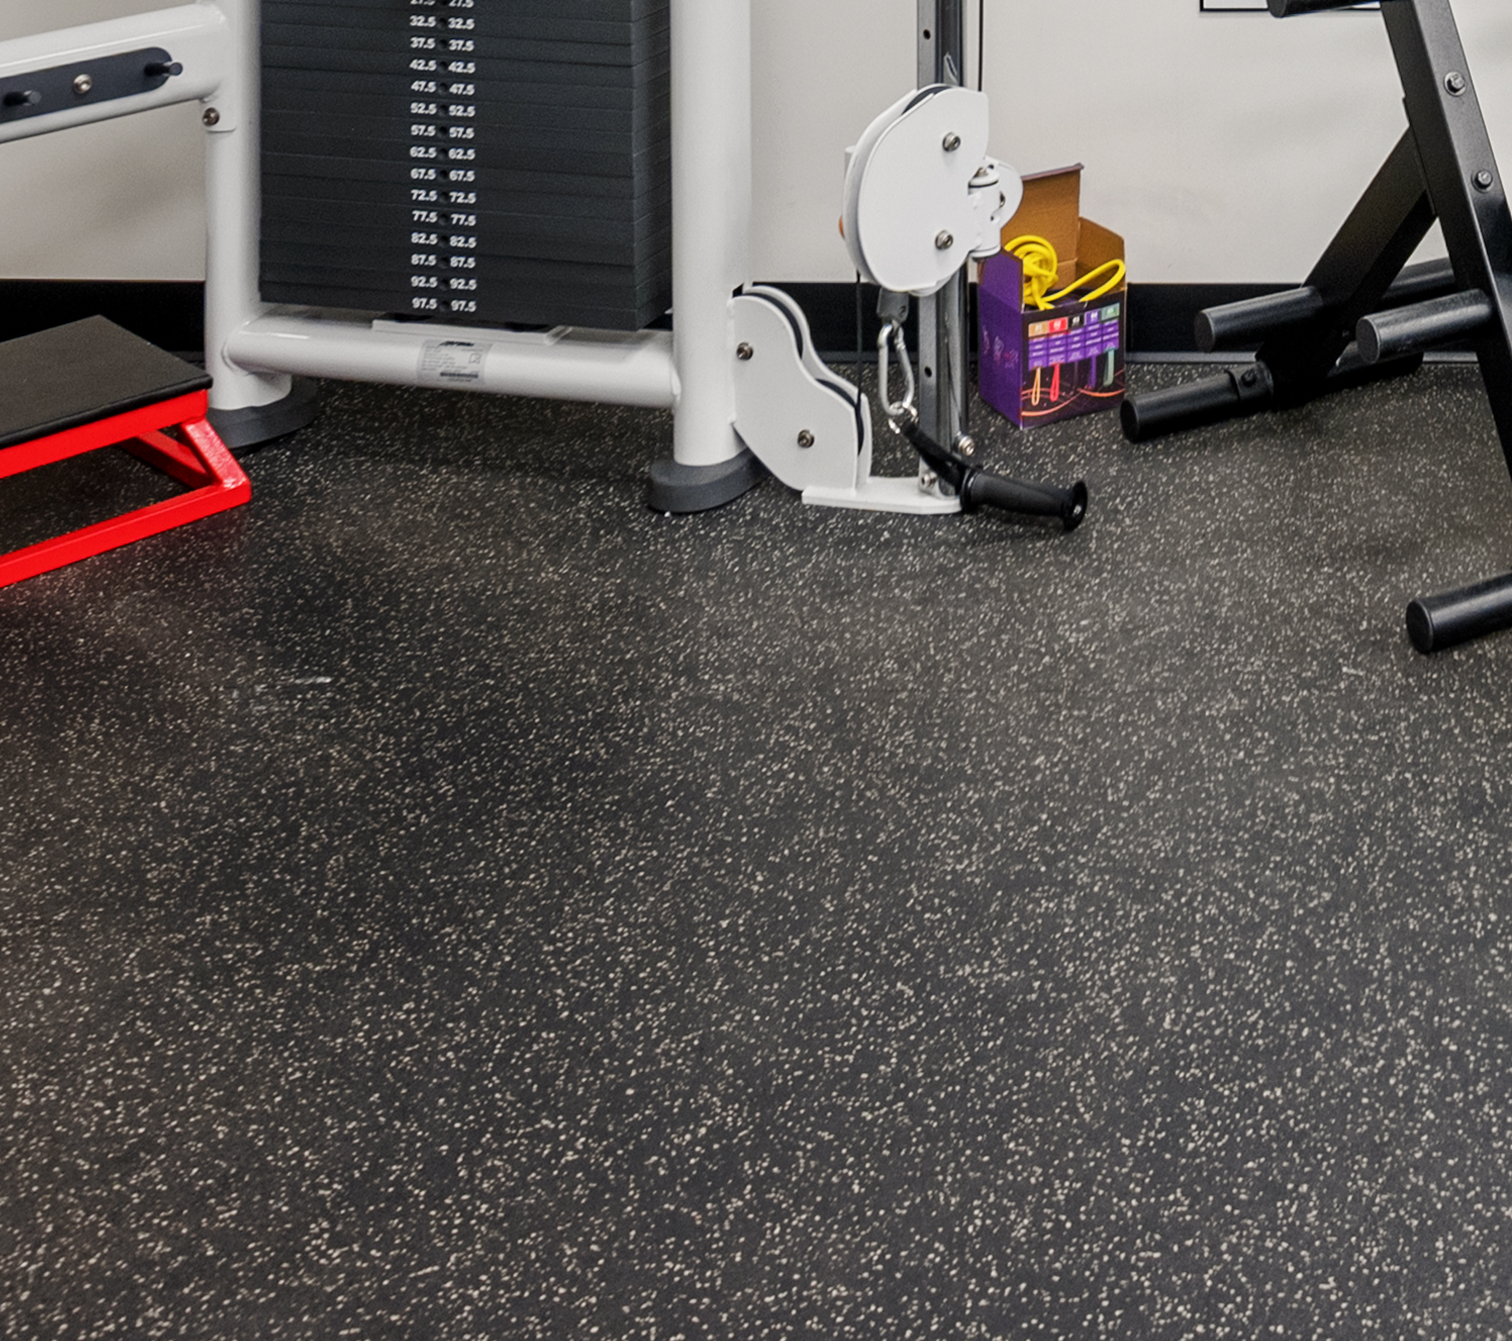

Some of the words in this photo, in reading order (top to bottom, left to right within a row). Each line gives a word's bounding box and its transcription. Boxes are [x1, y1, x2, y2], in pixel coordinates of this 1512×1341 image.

[409, 15, 437, 28] 32.5
[448, 17, 475, 30] 32.5
[410, 36, 436, 50] 37.5
[448, 39, 475, 52] 37.5
[409, 58, 437, 72] 42.5
[447, 61, 476, 74] 42.5
[410, 80, 437, 93] 47.5
[448, 83, 475, 96] 47.5
[410, 102, 438, 115] 52.5
[448, 104, 476, 118] 52.5
[410, 124, 437, 137] 57.5
[449, 126, 475, 139] 57.5
[409, 146, 437, 159] 62.5
[448, 148, 476, 161] 62.5
[410, 167, 437, 180] 67.5
[449, 169, 476, 182] 67.5
[410, 189, 438, 202] 72.5
[449, 191, 477, 204] 72.5
[411, 209, 438, 223] 77.5
[450, 213, 477, 227] 77.5
[410, 232, 438, 245] 82.5
[449, 235, 477, 249] 82.5
[410, 253, 437, 266] 87.5
[450, 255, 476, 269] 87.5
[410, 275, 438, 288] 92.5
[449, 277, 477, 291] 92.5
[411, 297, 438, 310] 97.5
[450, 299, 477, 313] 97.5
